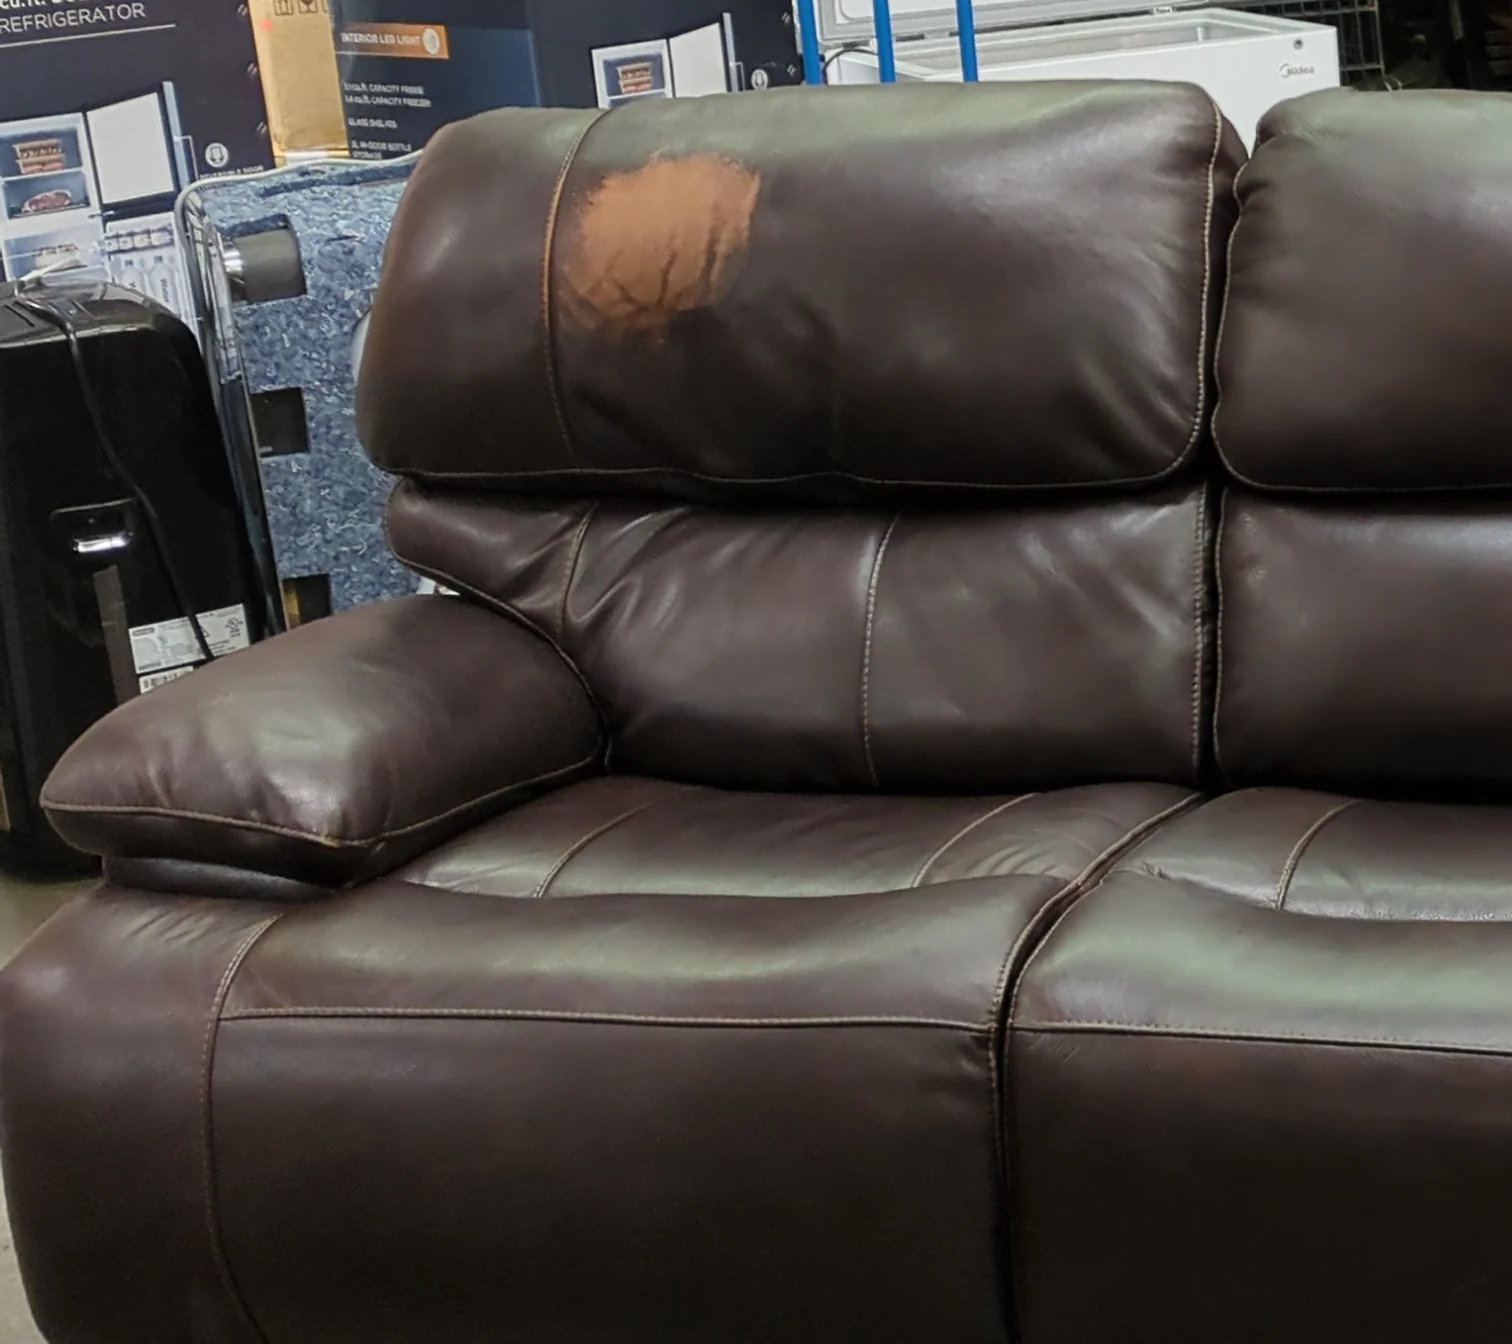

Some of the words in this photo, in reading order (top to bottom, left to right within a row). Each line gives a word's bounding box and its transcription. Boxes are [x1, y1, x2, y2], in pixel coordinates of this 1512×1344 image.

[0, 2, 147, 34] REFRIGERATOR
[340, 32, 379, 44] INTERIOR
[379, 34, 396, 45] LED
[397, 35, 421, 46] LIGHT
[1279, 62, 1315, 78] Midea
